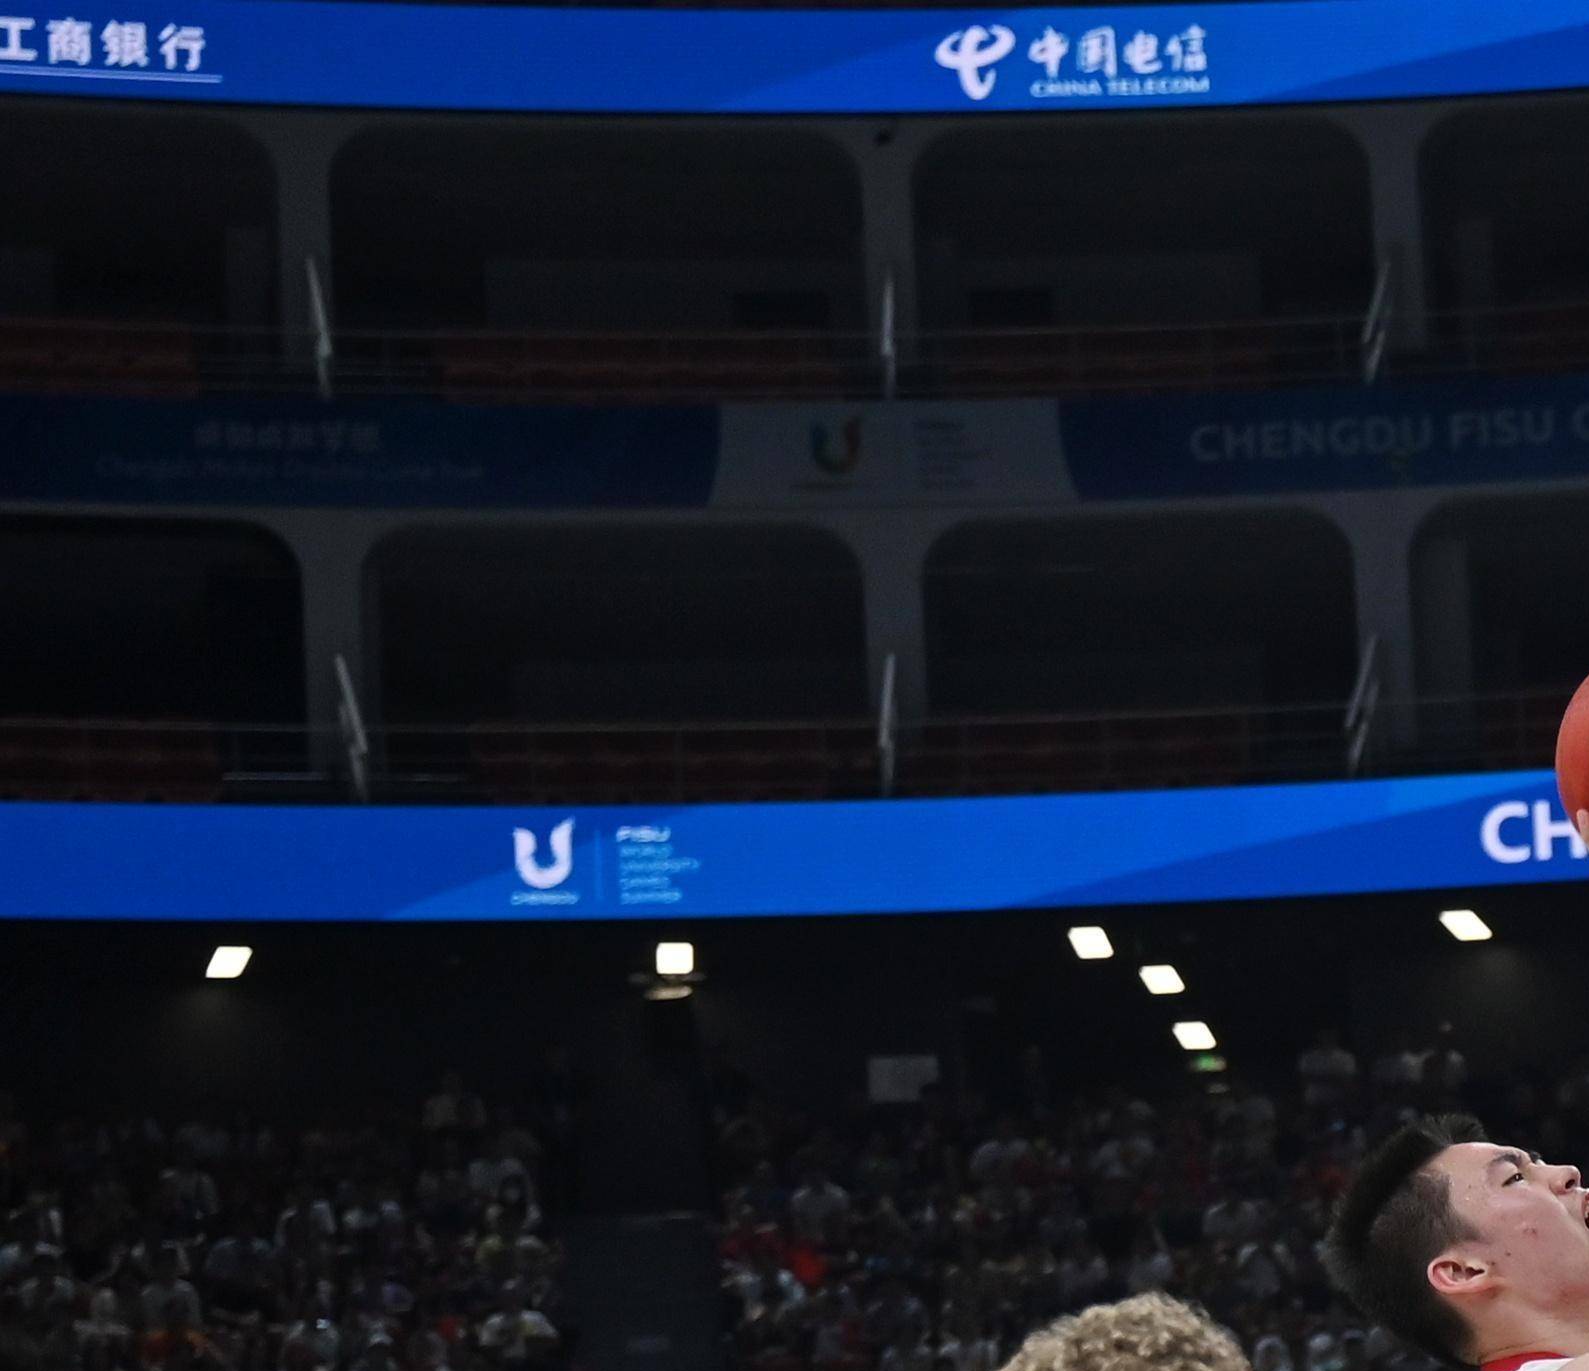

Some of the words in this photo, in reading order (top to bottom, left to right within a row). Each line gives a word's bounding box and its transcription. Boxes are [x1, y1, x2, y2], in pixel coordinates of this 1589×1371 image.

[1028, 25, 1208, 78] 中国电信
[1030, 80, 1101, 98] CHINA
[1106, 77, 1210, 96] TELECOM
